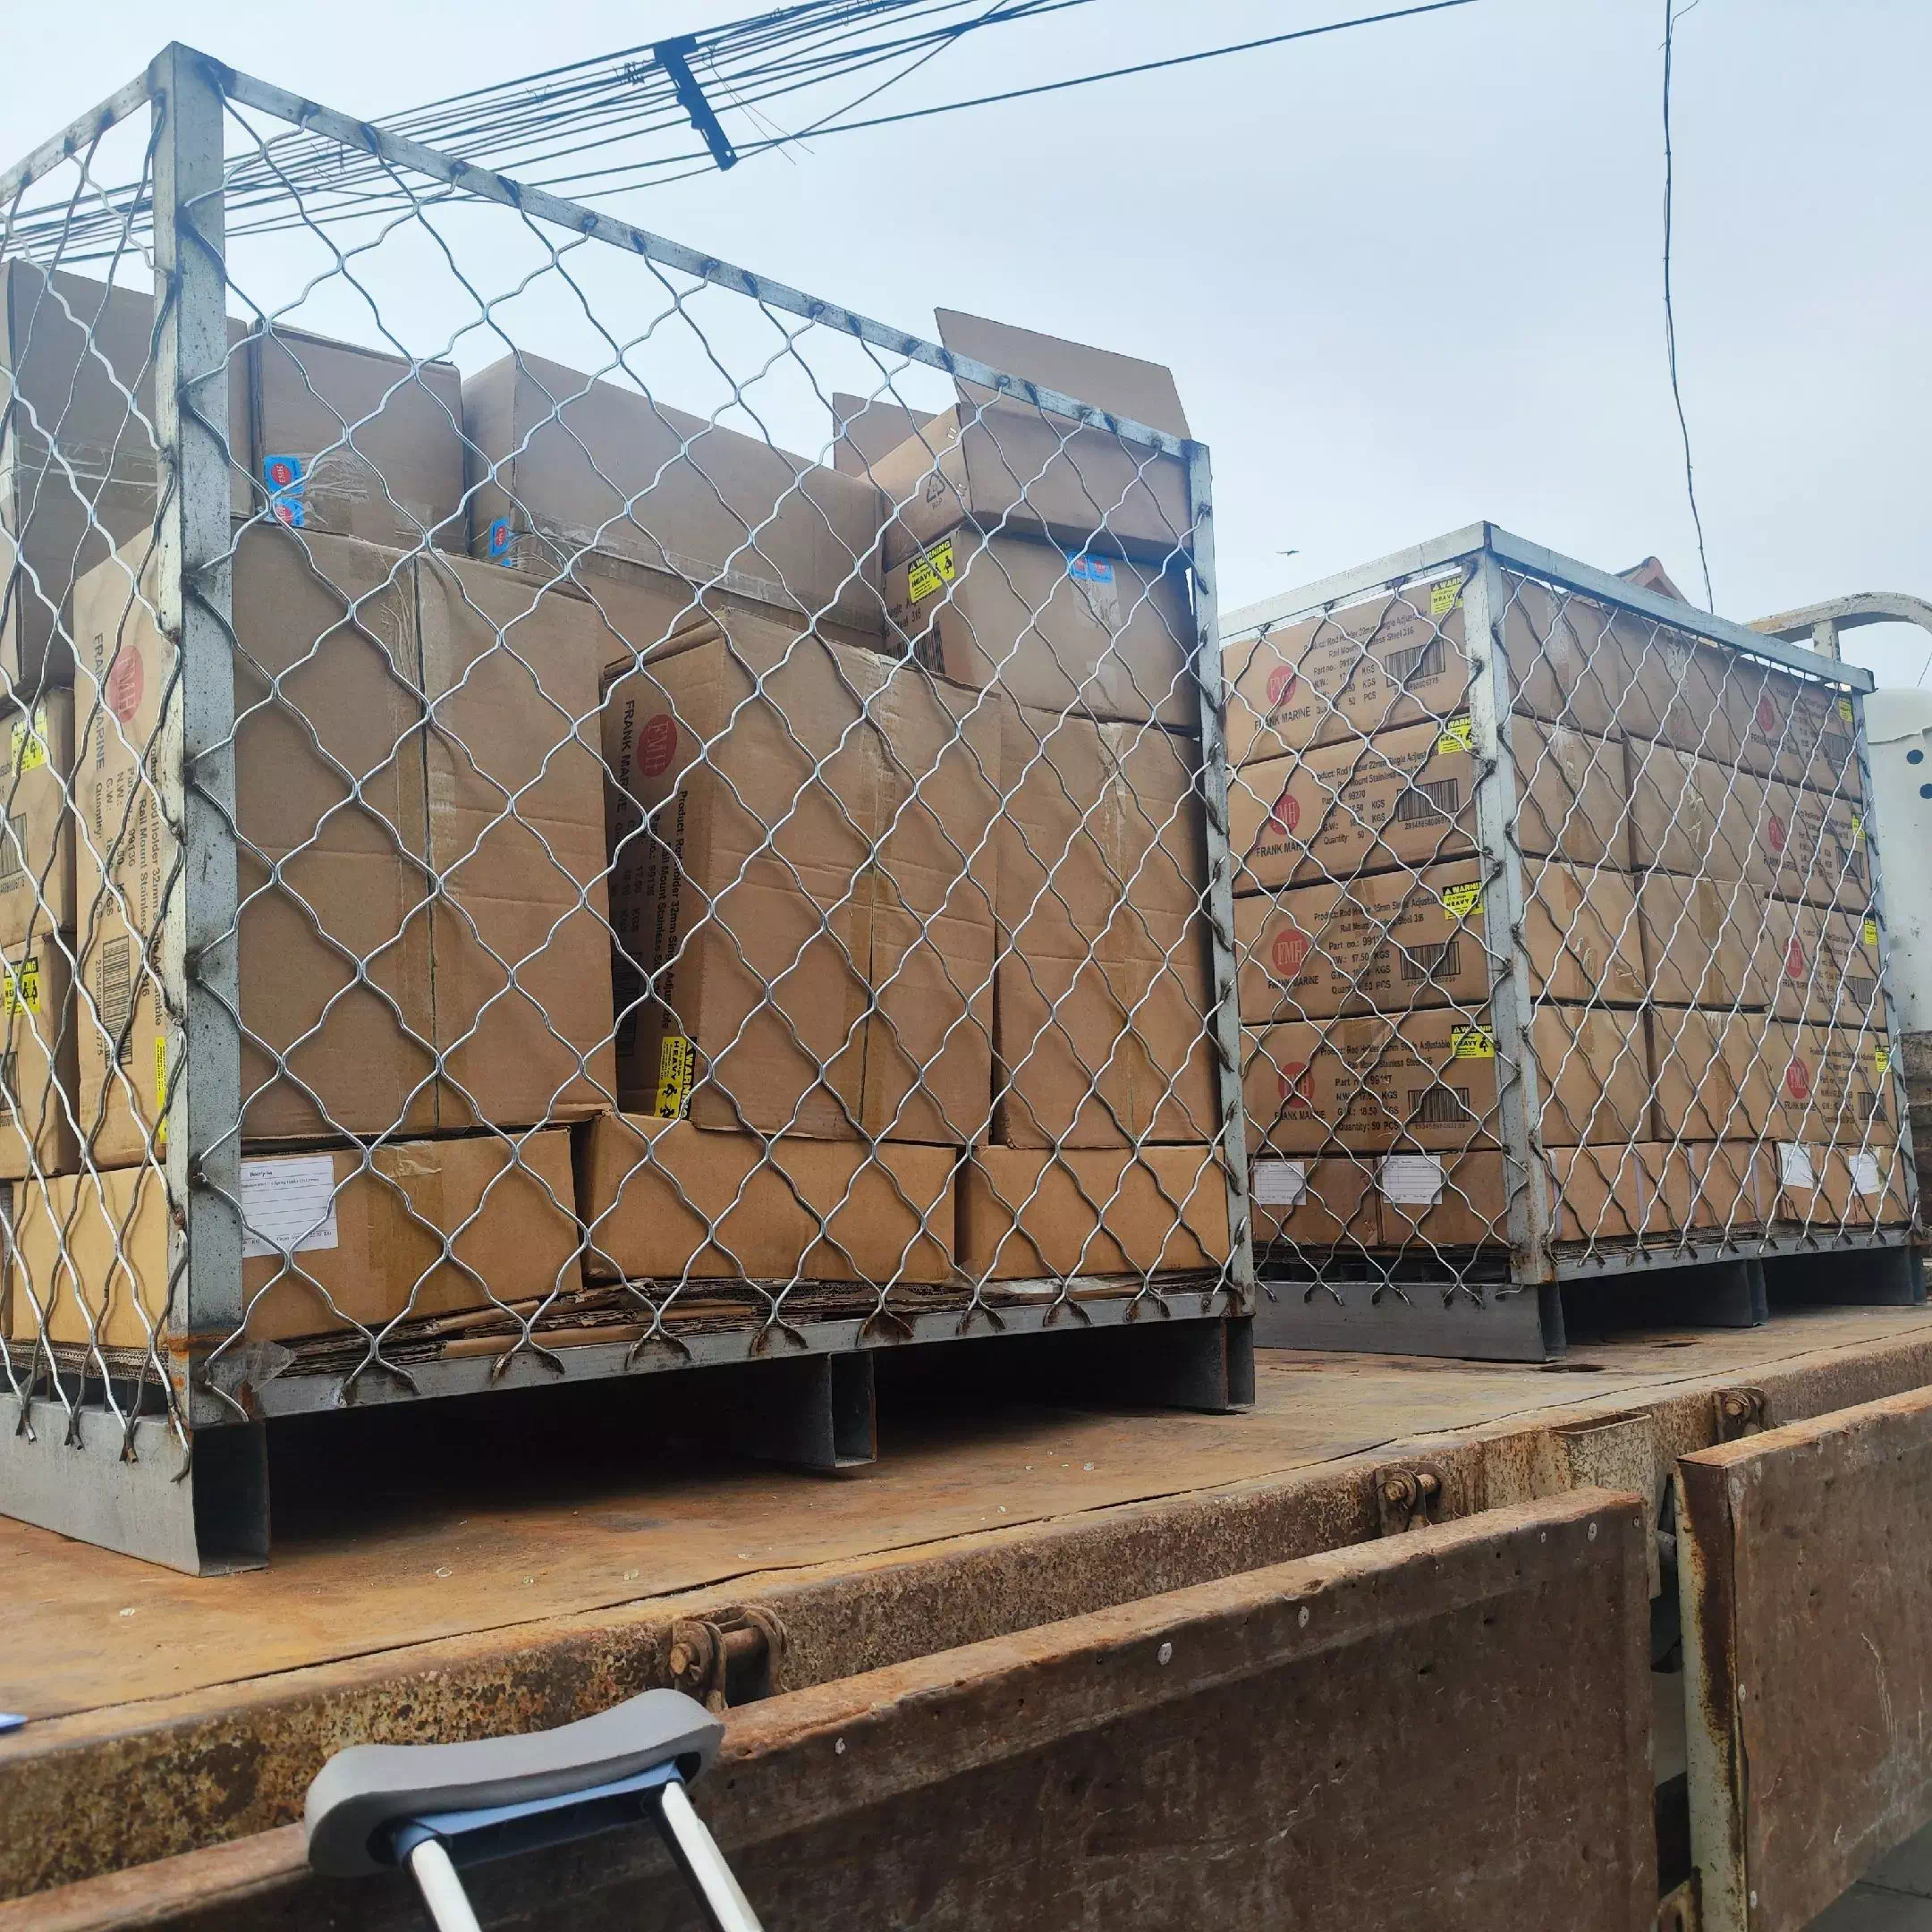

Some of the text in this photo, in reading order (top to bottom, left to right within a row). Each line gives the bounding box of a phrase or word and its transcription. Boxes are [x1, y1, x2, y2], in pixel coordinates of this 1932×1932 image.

[915, 541, 951, 566] WRNING
[1326, 635, 1339, 645] Rod
[1396, 610, 1427, 625] Adjustale
[93, 632, 104, 694] FRAN
[1362, 678, 1377, 690] KGS
[1363, 691, 1377, 702] PCS
[621, 699, 635, 752] FRANK
[1254, 716, 1280, 731] FANK
[1281, 706, 1311, 721] MARINE
[645, 719, 671, 772] FMH
[117, 771, 125, 806] N.W.:
[1311, 771, 1335, 781] Poduct:
[1336, 766, 1348, 776] Rod
[106, 777, 114, 812] G.W.:
[1371, 800, 1385, 809] KGS
[94, 782, 104, 841] Quantity:
[138, 798, 148, 825] Rail
[676, 790, 689, 837] Product:
[1371, 813, 1385, 824] KGS
[139, 827, 148, 869] Mount
[151, 820, 160, 866] Holder
[1256, 843, 1283, 858] FRANK
[1323, 835, 1350, 845] Quantity:
[151, 868, 161, 909] 32mm
[658, 865, 670, 899] Mount
[140, 871, 149, 934] Stainless
[668, 900, 681, 934] 32mm
[1314, 911, 1339, 921] Prodct:
[1339, 909, 1352, 919] Rod
[654, 901, 667, 953] Stainless
[665, 935, 678, 970] Singe
[1329, 941, 1343, 950] Part
[1376, 965, 1391, 974] KGS
[151, 954, 164, 1026] Adjstable
[661, 971, 675, 1030] Adjustble
[671, 1040, 680, 1080] HEAVY
[1419, 1040, 1450, 1051] Adjustable
[1335, 1077, 1352, 1087] Part
[1381, 1090, 1398, 1100] KGS
[1299, 1109, 1326, 1120] MARNE
[1359, 1106, 1377, 1115] 18.50
[1371, 1122, 1381, 1131] 50
[1383, 1121, 1399, 1131] PCS
